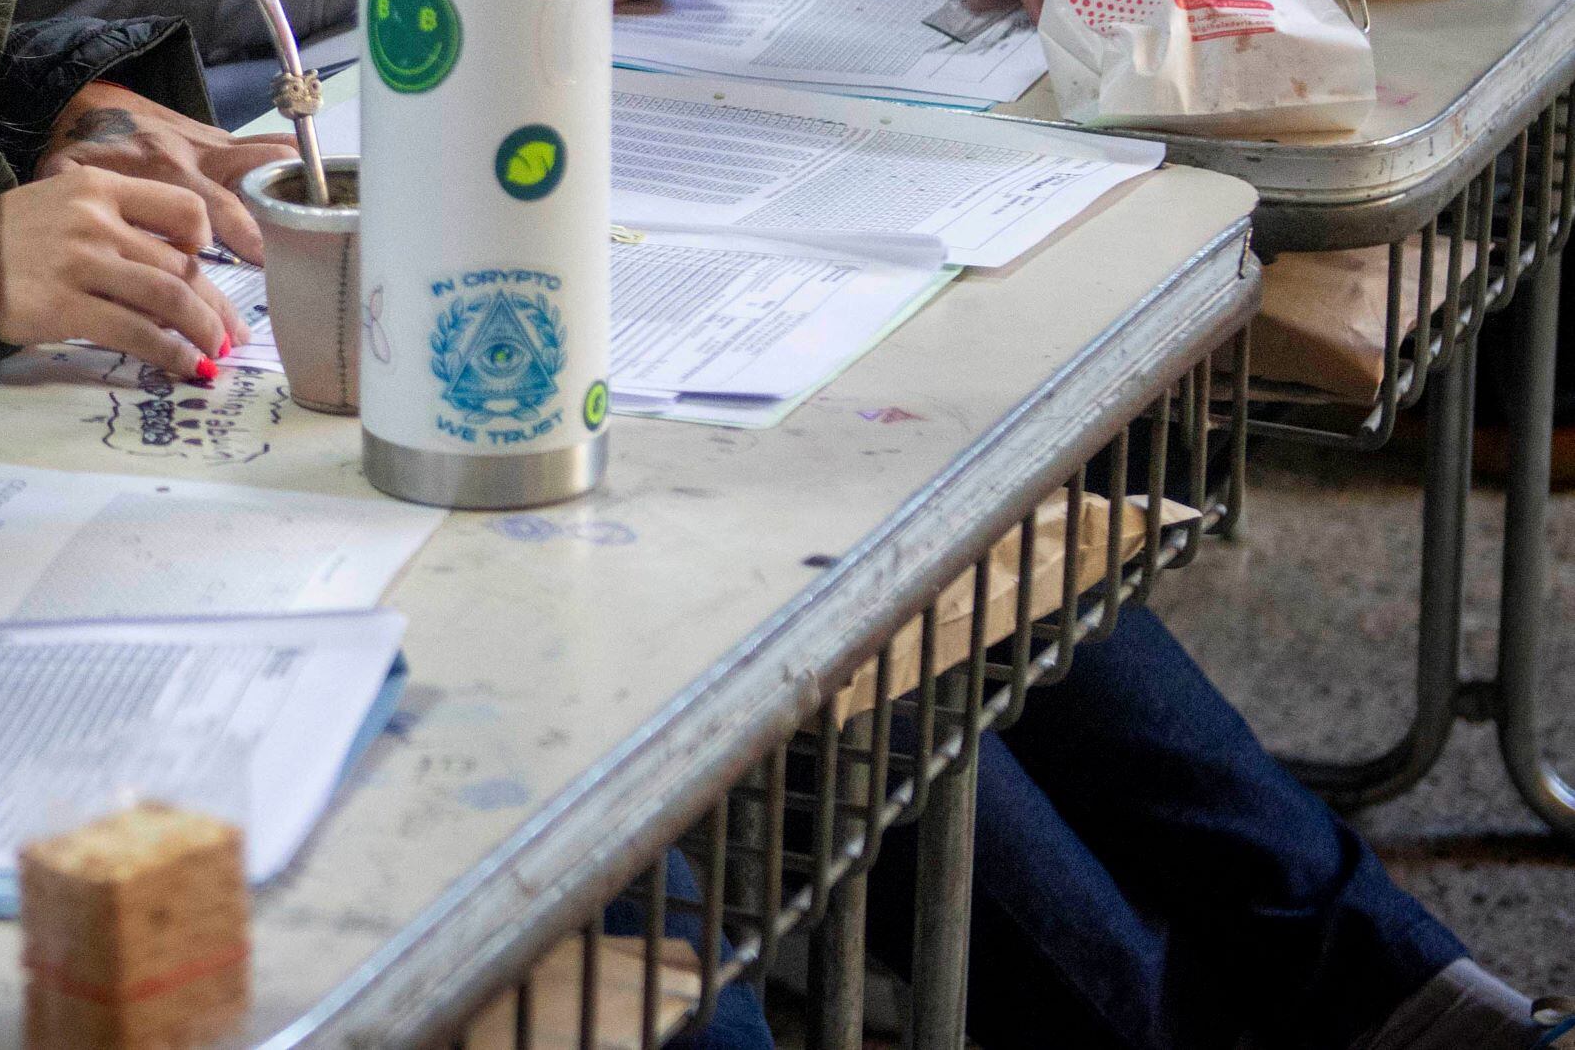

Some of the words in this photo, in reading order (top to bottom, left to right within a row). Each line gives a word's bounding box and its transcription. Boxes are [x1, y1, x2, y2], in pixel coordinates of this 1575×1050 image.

[431, 278, 455, 296] IN
[463, 269, 561, 291] CRYPTO
[436, 413, 476, 443] WE
[487, 407, 564, 445] TRUST
